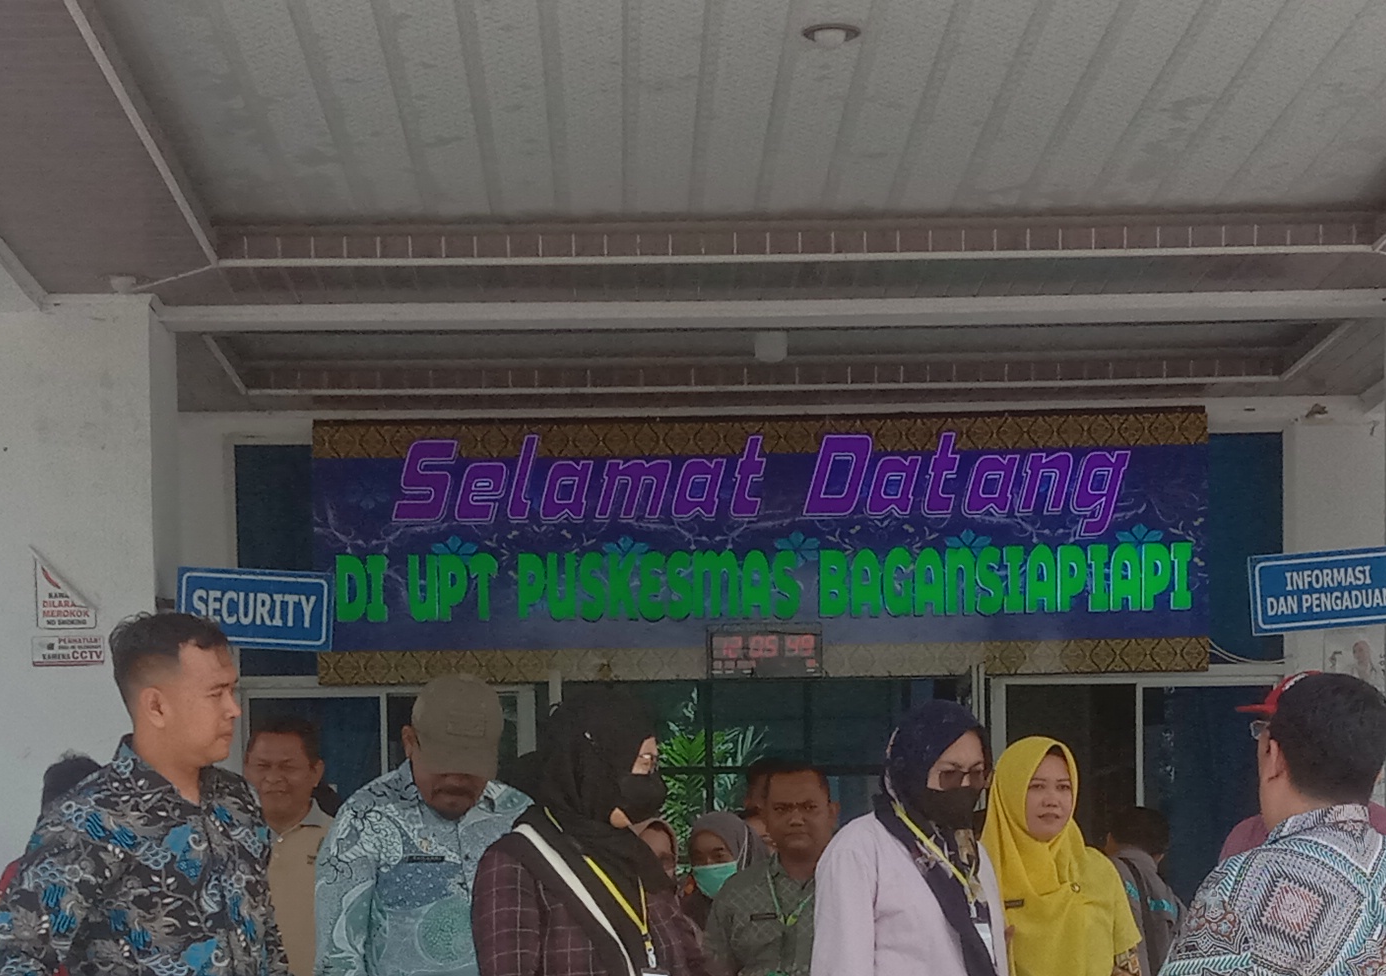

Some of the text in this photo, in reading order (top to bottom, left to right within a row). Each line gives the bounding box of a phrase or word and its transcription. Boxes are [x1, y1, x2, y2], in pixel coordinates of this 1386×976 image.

[391, 432, 1132, 538] Selamat Datang
[335, 541, 1193, 622] DI UPT PUSKESMAS BAGANSIAPIAPI
[1284, 565, 1372, 591] INFORMASI
[43, 600, 76, 608] DILARA
[192, 589, 317, 628] SECURITY
[1266, 595, 1298, 617] DAN
[72, 651, 102, 660] CCTV
